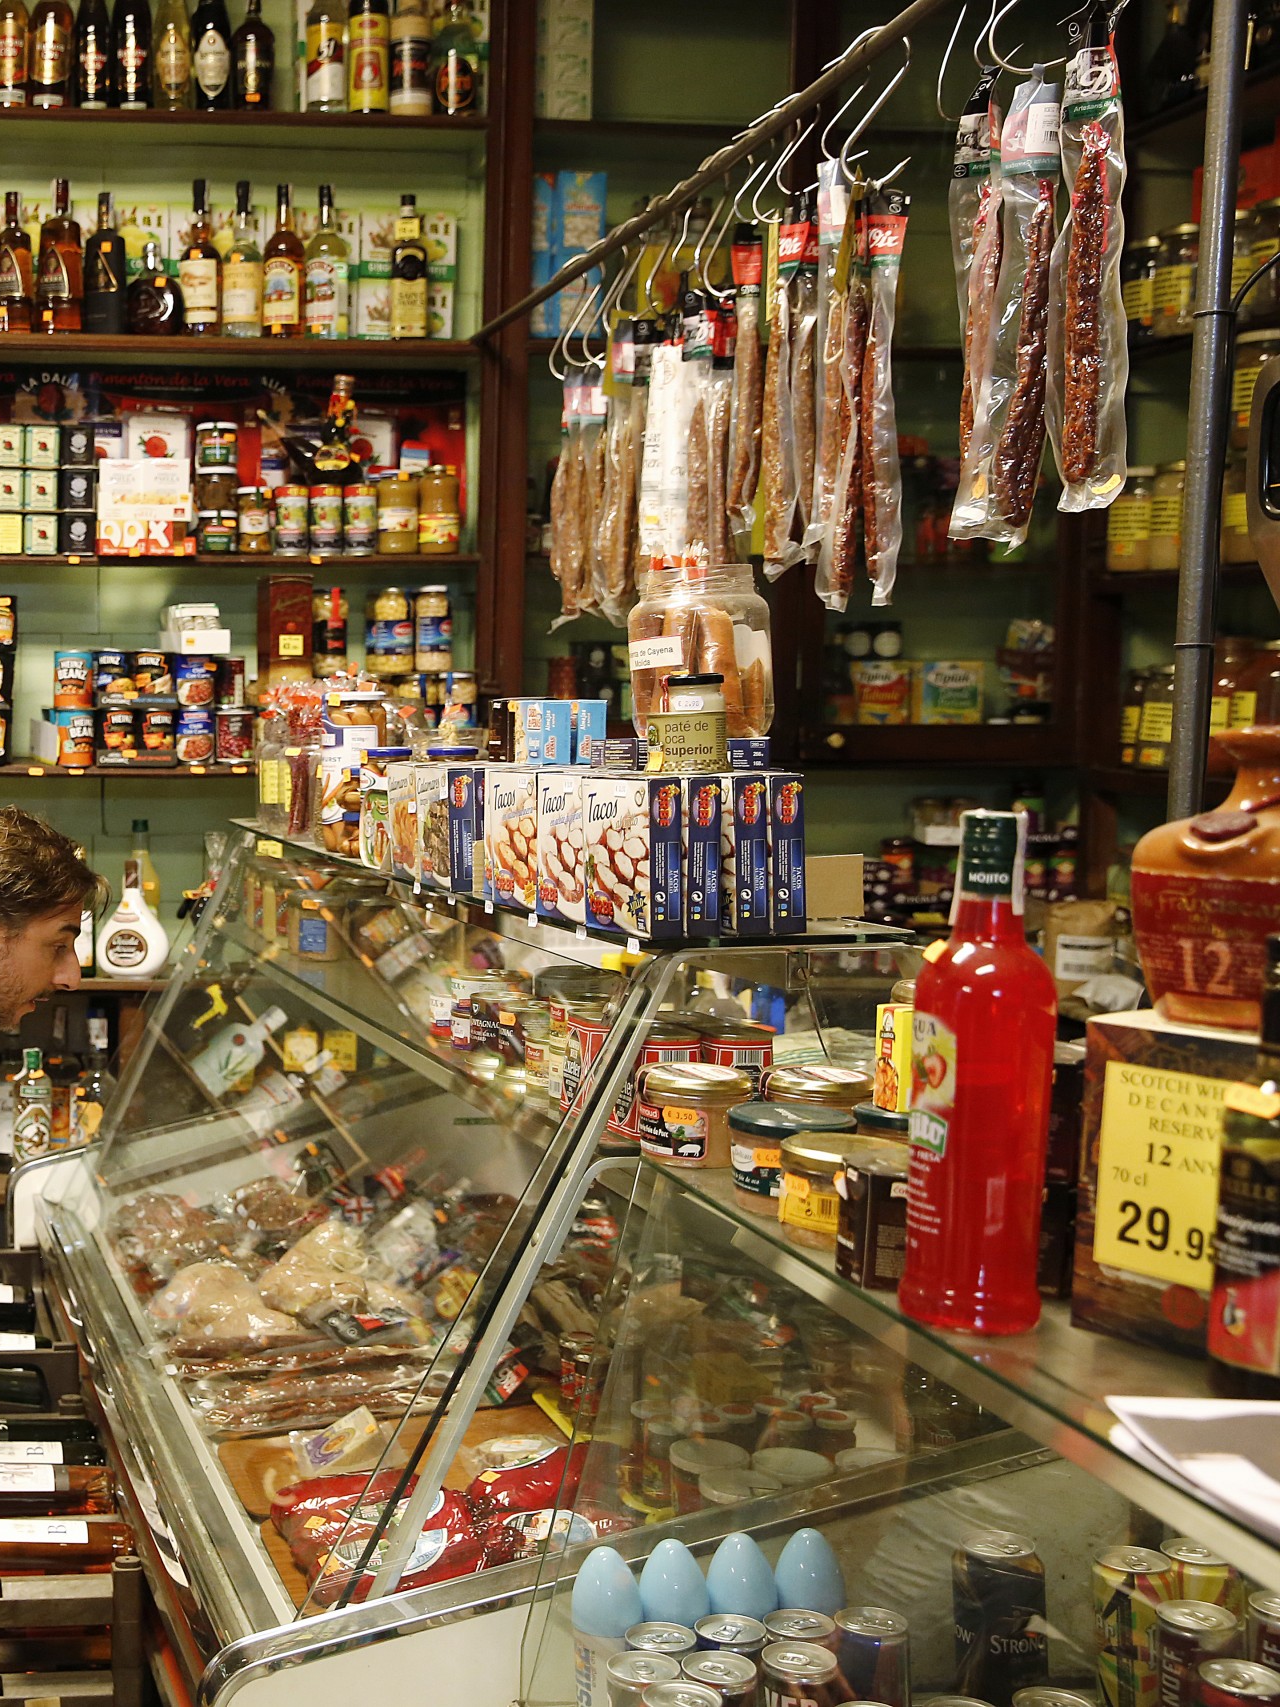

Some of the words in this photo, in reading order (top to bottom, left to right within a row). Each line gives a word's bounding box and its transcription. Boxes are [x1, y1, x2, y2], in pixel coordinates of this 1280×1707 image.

[634, 658, 651, 668] Molida
[647, 646, 674, 656] Cayena
[664, 720, 690, 736] paté
[693, 720, 709, 732] de
[664, 734, 686, 744] oca
[664, 744, 714, 757] superior
[453, 777, 463, 808] ORBE
[493, 784, 517, 811] Tacos
[542, 787, 567, 816] Tacos
[743, 785, 756, 825] ORBE
[783, 784, 794, 825] ORBE
[588, 792, 618, 824] Tacos
[658, 785, 671, 828] ORBE
[698, 786, 711, 828] ORBE
[968, 871, 1010, 886] MOJITO
[1178, 937, 1235, 996] 12
[1121, 1069, 1190, 1096] SCOTCH
[1148, 1117, 1219, 1143] RESERV
[1145, 1142, 1173, 1167] 12
[1177, 1155, 1220, 1177] ANY
[1112, 1166, 1130, 1183] 70
[1133, 1172, 1148, 1188] cl
[990, 1634, 1048, 1656] STRONG
